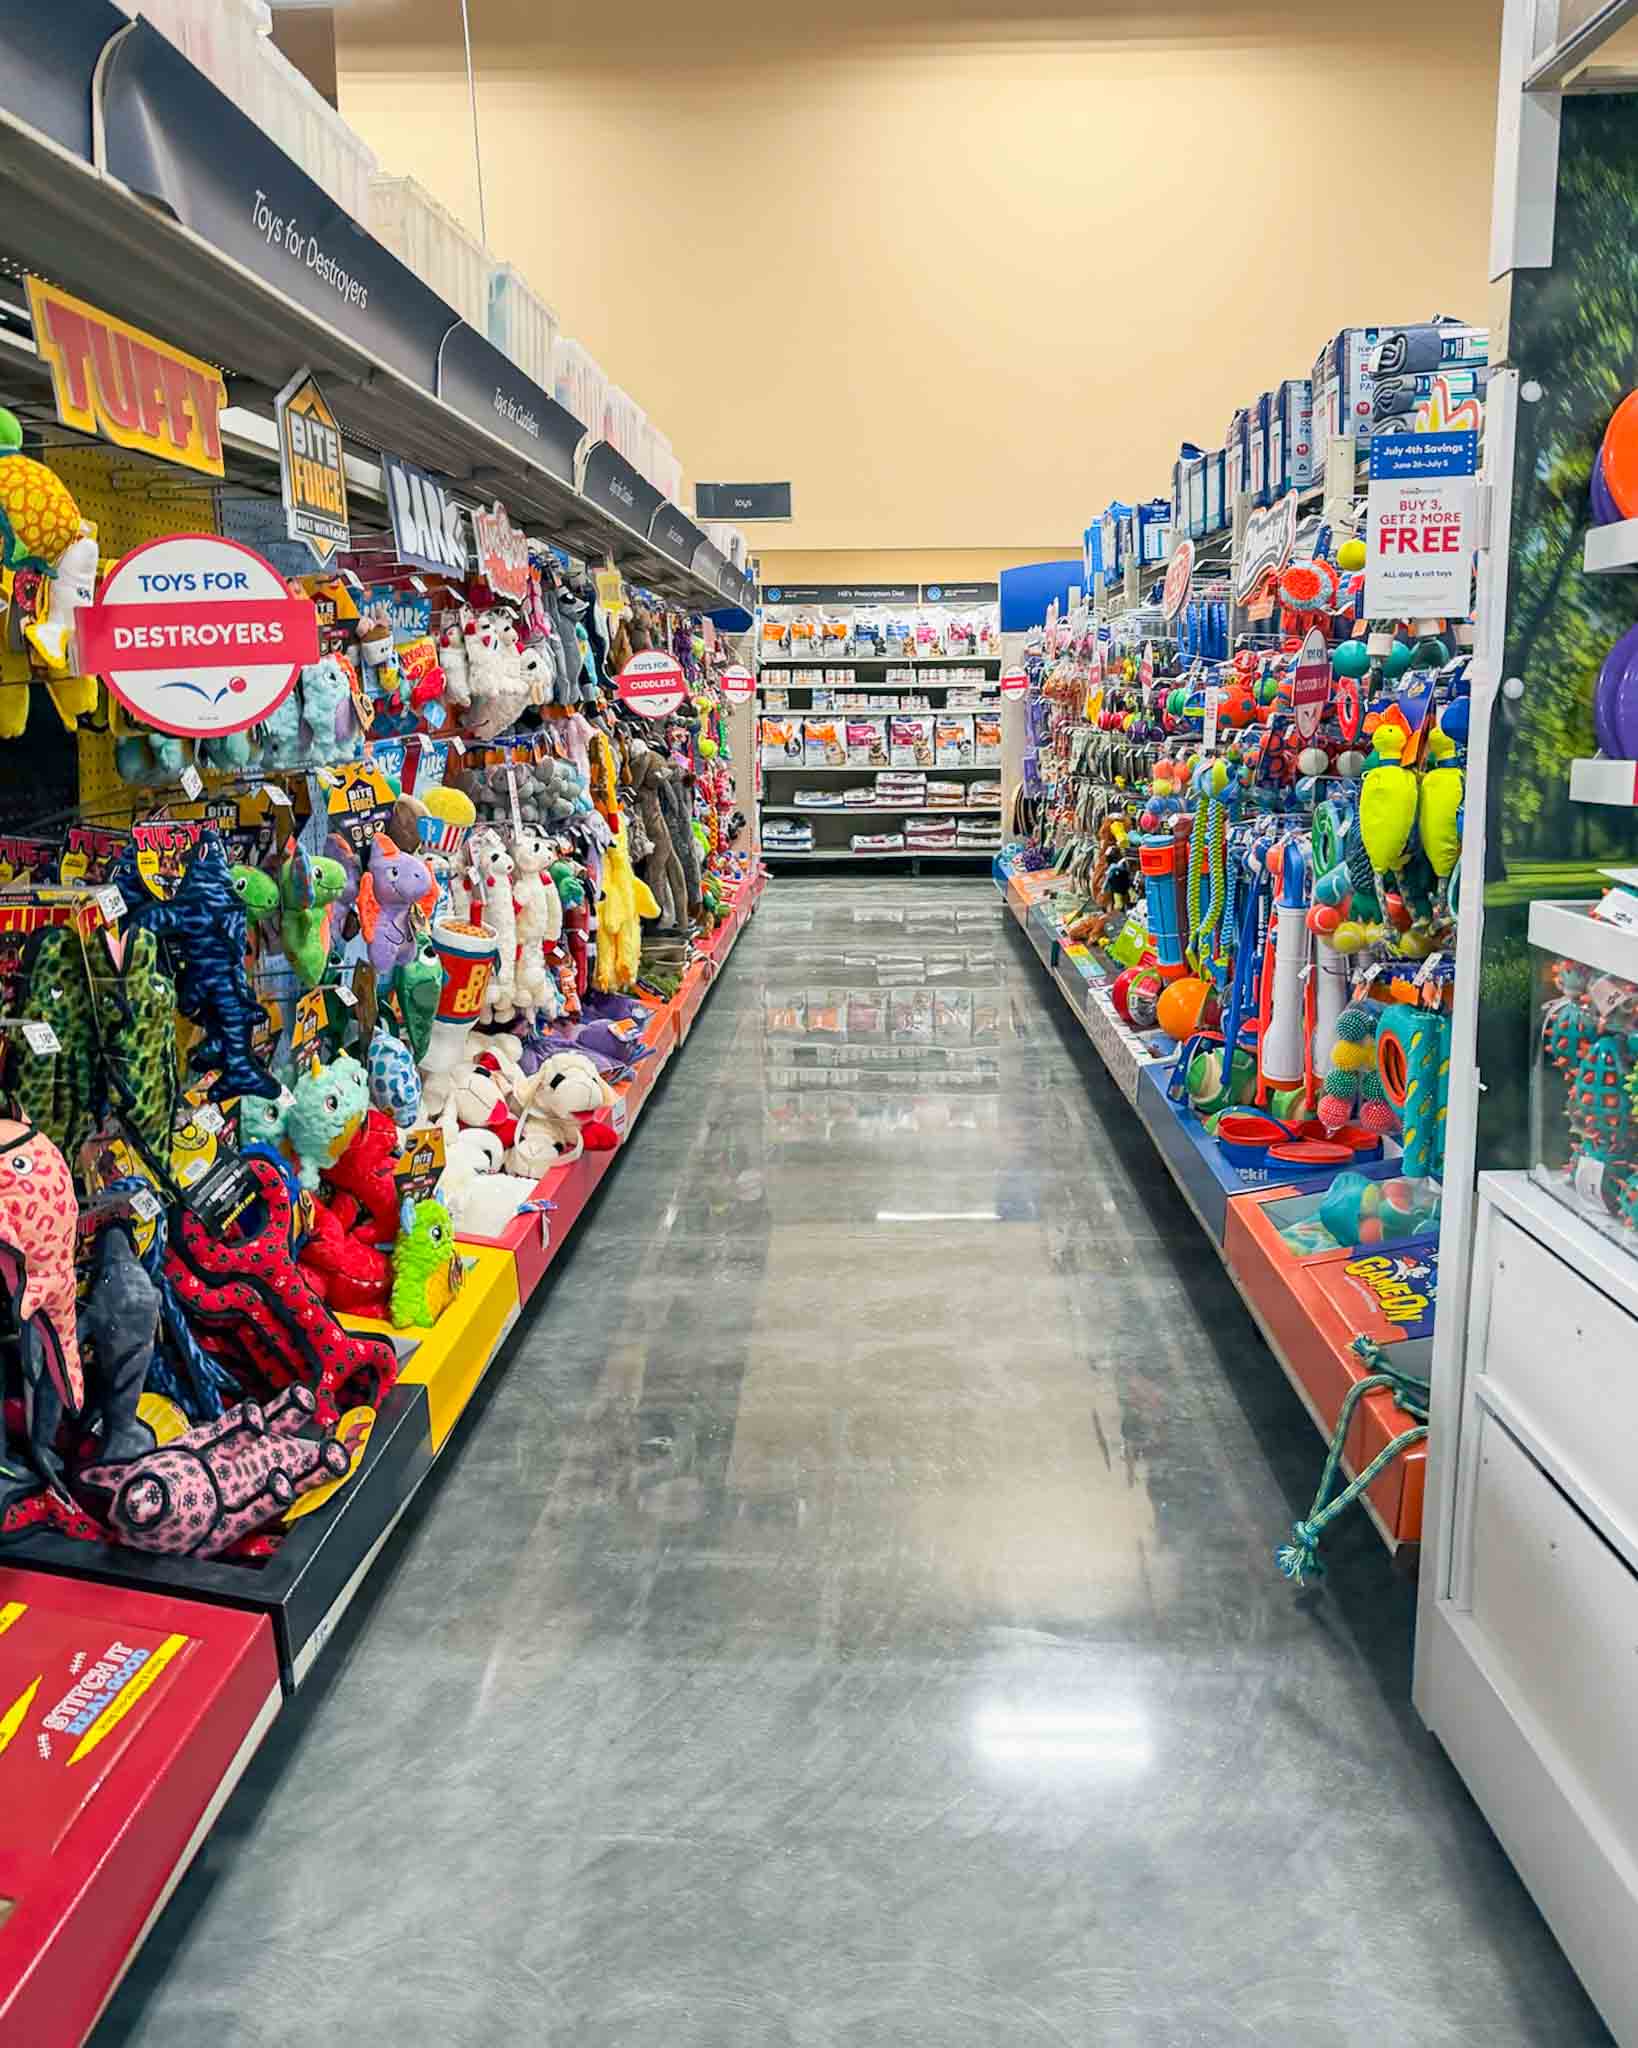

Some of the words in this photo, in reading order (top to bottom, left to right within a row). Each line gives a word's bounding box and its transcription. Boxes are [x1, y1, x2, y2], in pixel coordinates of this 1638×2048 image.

[252, 189, 283, 244] Toys
[284, 218, 306, 259] for
[306, 236, 368, 310] Destroyers
[43, 296, 222, 461] TUFFY
[493, 386, 507, 417] Toys
[291, 411, 338, 472] BITE
[1383, 446, 1404, 457] July
[1405, 445, 1423, 454] 4th
[1424, 443, 1463, 455] Savings
[1392, 462, 1411, 470] June
[294, 456, 342, 514] FORCE
[1400, 500, 1425, 511] BUY
[1431, 499, 1442, 511] 3,
[1380, 514, 1405, 525] GET
[1409, 513, 1417, 524] 2
[1421, 511, 1461, 523] MORE
[1379, 525, 1460, 554] FREE
[138, 575, 196, 592] TOYS
[203, 572, 248, 590] FOR
[1437, 569, 1453, 578] toys
[113, 622, 285, 649] DESTROYERS
[633, 662, 653, 671] TOYS
[655, 661, 670, 669] FOR
[630, 677, 678, 690] CUDDLERS
[347, 786, 374, 801] BITE
[207, 806, 237, 818] BITE
[131, 823, 201, 851] TUFFY
[42, 1660, 119, 1731] STITCH
[103, 1640, 133, 1663] IT
[64, 1690, 116, 1736] REAL
[105, 1648, 150, 1692] GOOD
